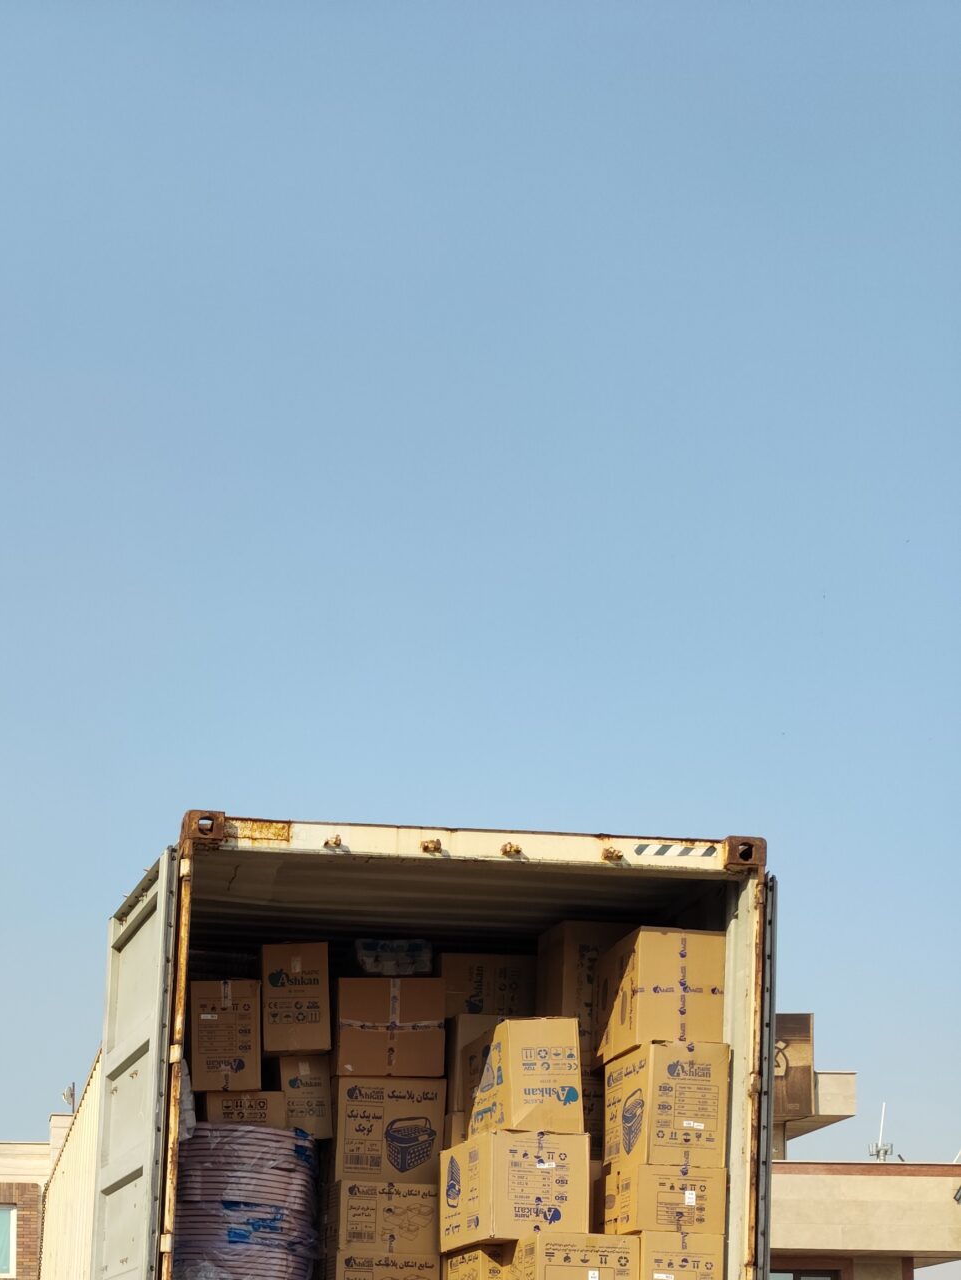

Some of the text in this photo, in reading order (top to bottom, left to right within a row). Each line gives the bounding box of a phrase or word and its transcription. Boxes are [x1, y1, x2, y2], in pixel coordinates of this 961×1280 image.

[274, 970, 319, 987] Ashkan
[387, 1090, 438, 1103] اشکان پلاستیک
[399, 1261, 417, 1269] اشکان
